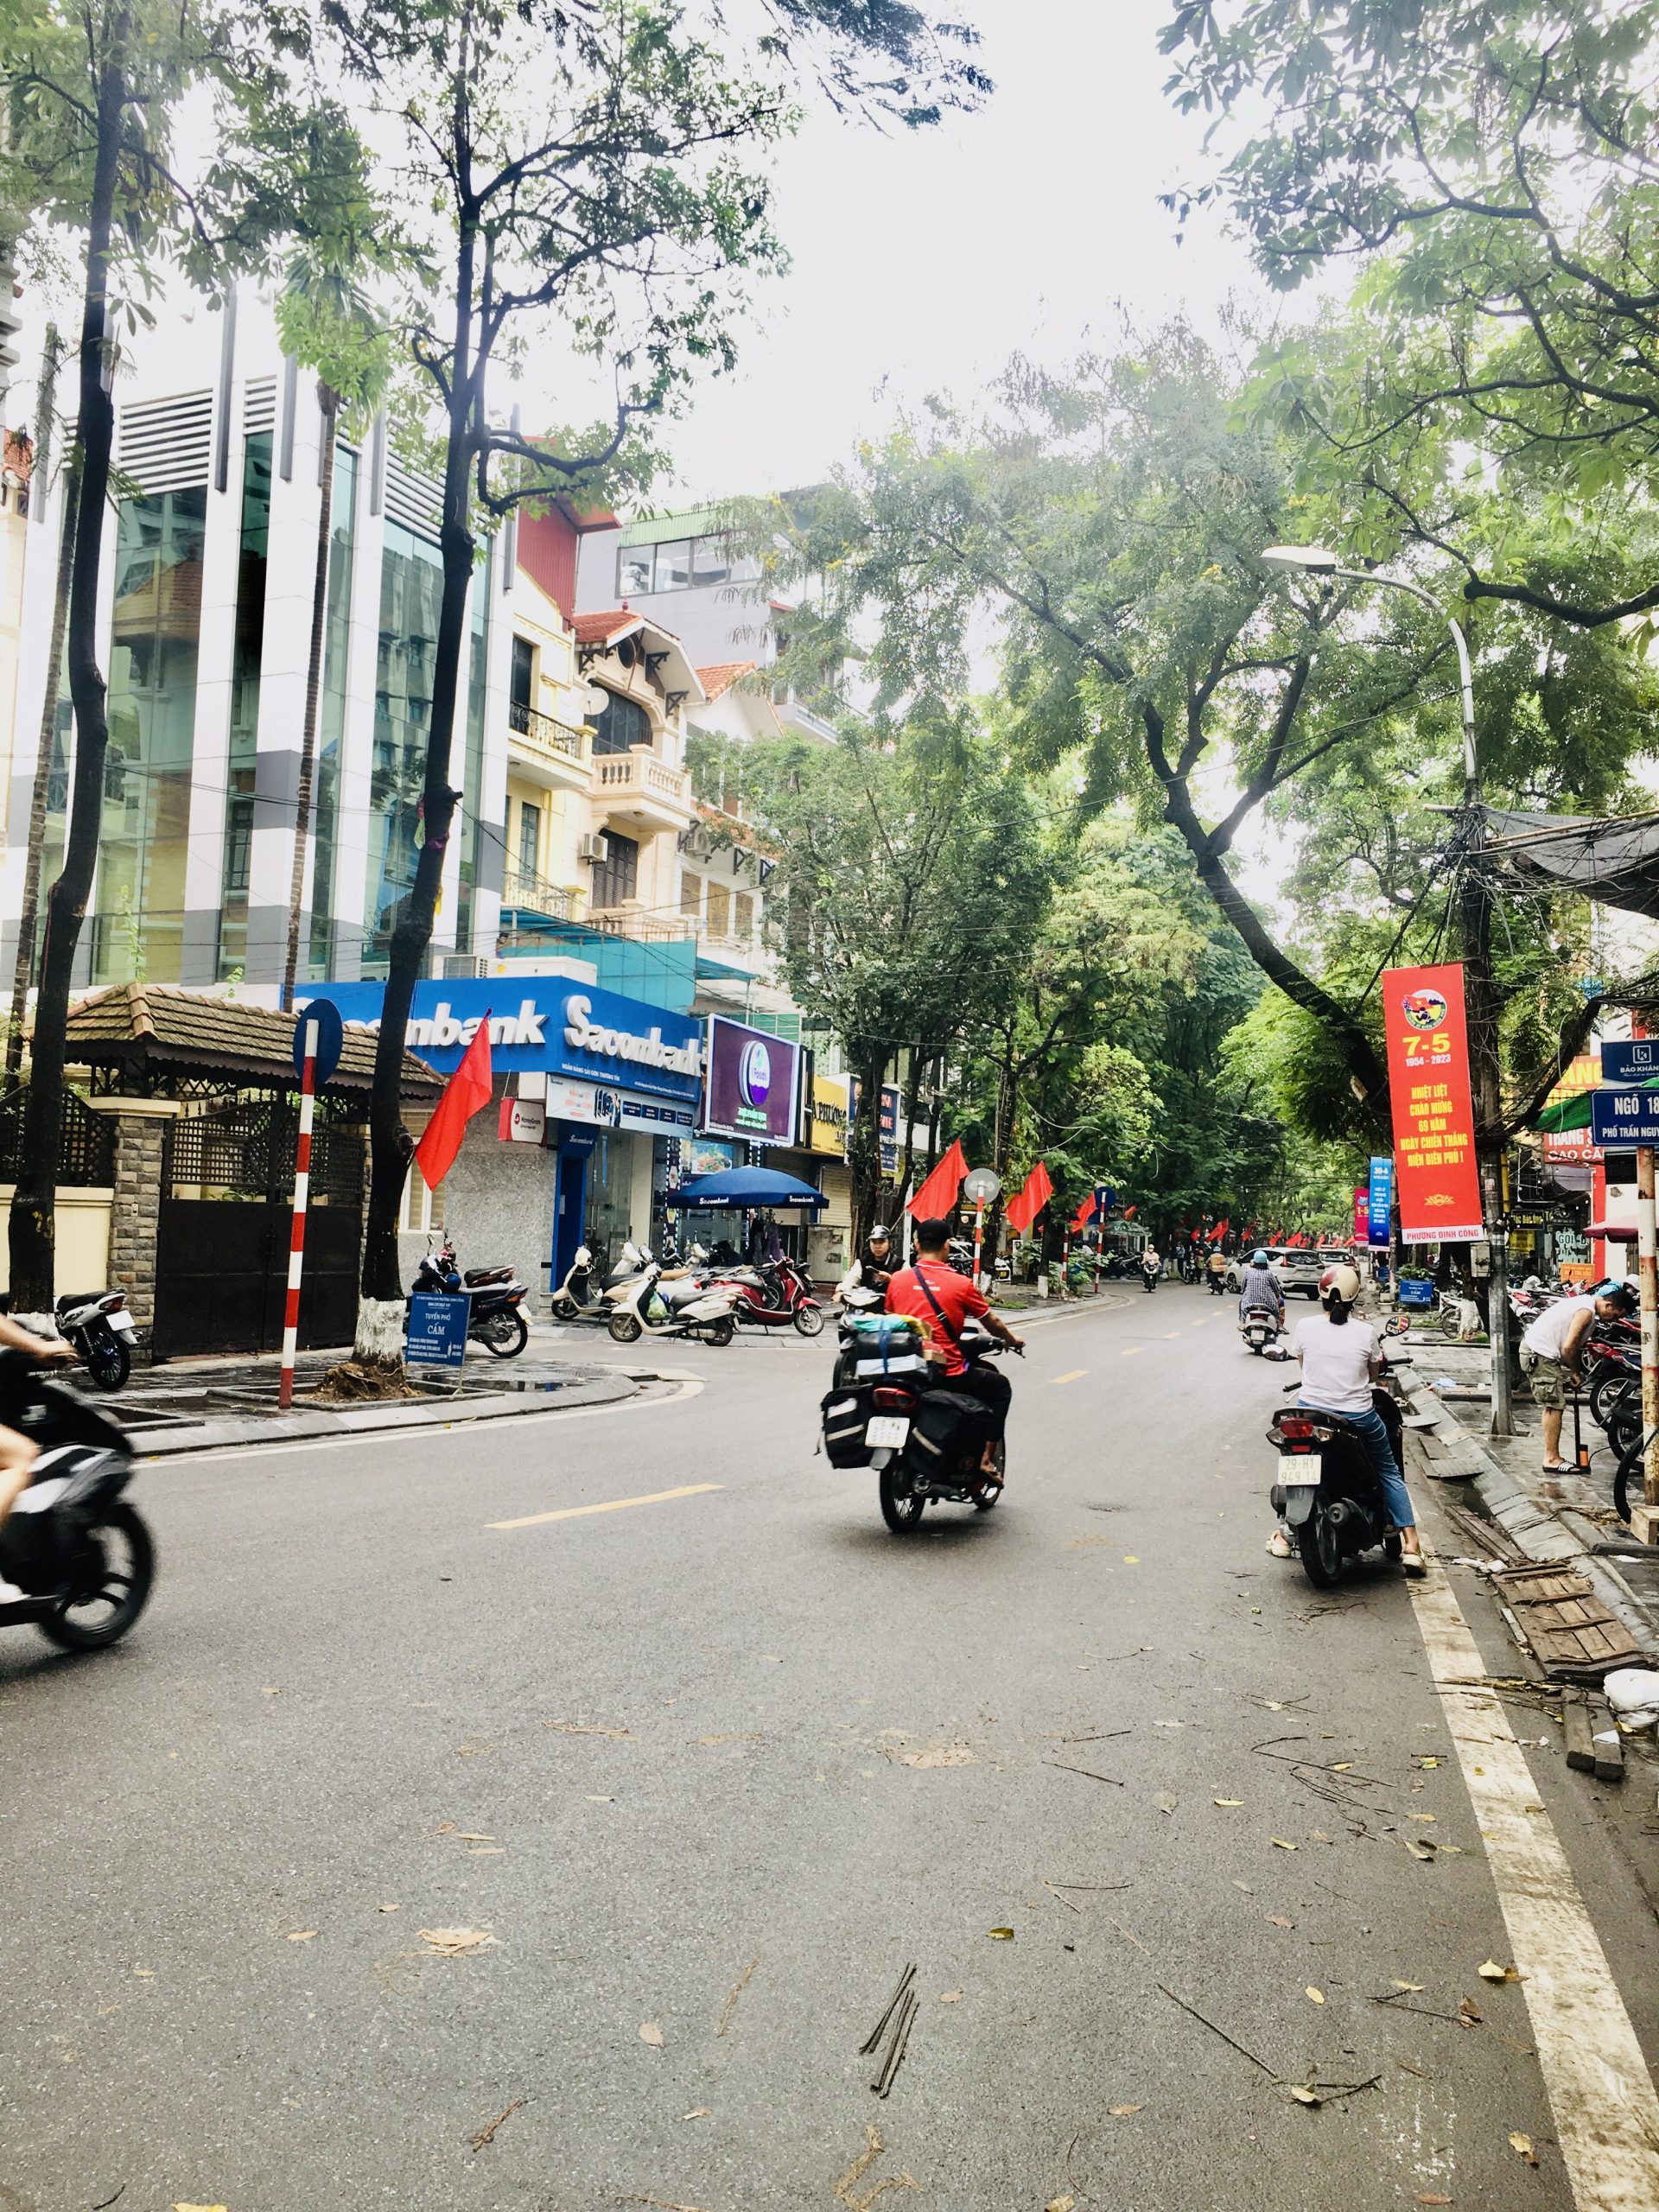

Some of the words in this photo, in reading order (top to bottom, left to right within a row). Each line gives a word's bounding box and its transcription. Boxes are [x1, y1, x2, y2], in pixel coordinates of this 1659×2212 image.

[564, 995, 702, 1077] Sacombank
[1405, 1056, 1424, 1067] 1954
[1431, 1054, 1452, 1065] 2023
[1411, 1084, 1432, 1100] NHIỆT
[1433, 1083, 1448, 1099] LIỆT
[1409, 1101, 1429, 1116] CHÀO
[1614, 1093, 1640, 1116] NGÕ
[1418, 1120, 1429, 1133] 69
[1602, 1124, 1618, 1138] PHỐ
[1400, 1135, 1419, 1150] NGÀY
[1421, 1132, 1442, 1148] CHIẾN
[1443, 1130, 1468, 1147] THẮNG
[427, 1322, 446, 1335] CẤM
